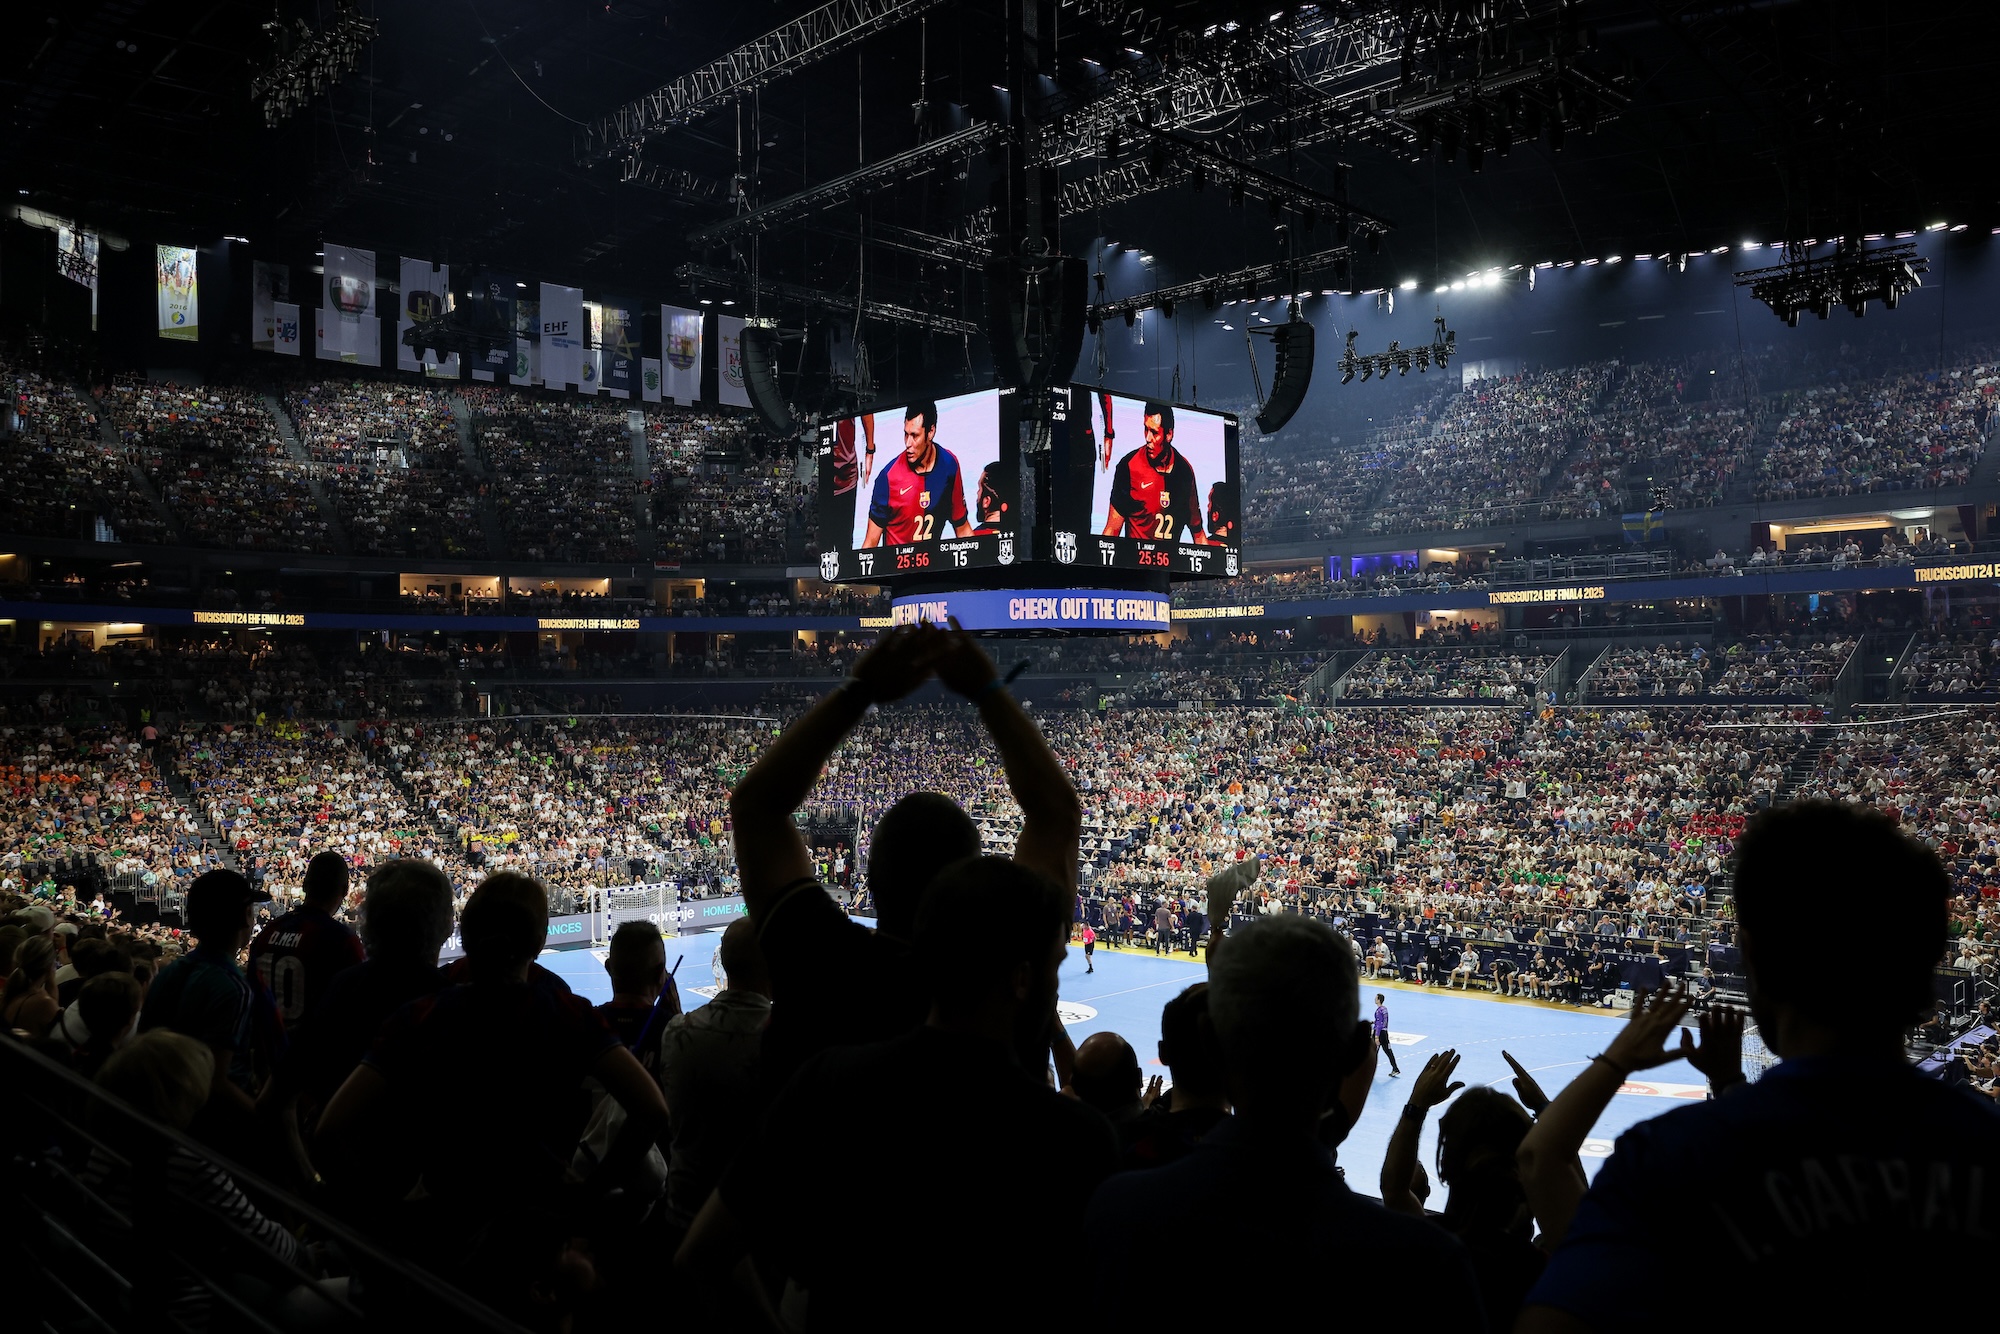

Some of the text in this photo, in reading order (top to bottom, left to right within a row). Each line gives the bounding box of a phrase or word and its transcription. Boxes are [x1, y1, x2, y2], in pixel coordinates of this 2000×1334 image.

[169, 303, 188, 311] 2016
[544, 321, 568, 333] EHF
[1056, 402, 1064, 411] 22
[1053, 412, 1066, 421] 2:00
[823, 437, 830, 445] 22
[819, 447, 831, 455] 2:00
[913, 513, 934, 541] 22
[1154, 513, 1174, 540] 22
[940, 541, 979, 552] SC Magdeburg
[1099, 540, 1115, 550] Barça
[1178, 547, 1188, 556] SC
[858, 552, 873, 561] Barça
[897, 552, 930, 569] 25:56
[953, 551, 968, 567] 15
[1101, 550, 1115, 565] 17
[1139, 550, 1170, 567] 25:56
[860, 560, 874, 576] 17
[1190, 557, 1202, 572] 15
[1913, 564, 1994, 582] TRUCKSCOUT24
[1488, 586, 1605, 604] TRUCKSCOUT24 EHF FINAL4 2025
[905, 603, 919, 625] FAN
[920, 601, 948, 624] ZONE
[1009, 598, 1058, 620] CHECK
[1060, 598, 1089, 619] OUT
[1091, 598, 1115, 620] THE
[1116, 599, 1156, 621] OFFICIAL
[1171, 600, 1265, 620] TRUCKSCOUT24 EHF FINAL4 2025
[193, 611, 305, 626] TRUCKSCOUT24 EHF FINAL4 2025
[538, 618, 640, 630] TRUCKSCOUT24 EHF FINAL4 2025
[649, 896, 695, 925] gorenje
[703, 904, 732, 917] HOME
[547, 921, 582, 936] ANCES
